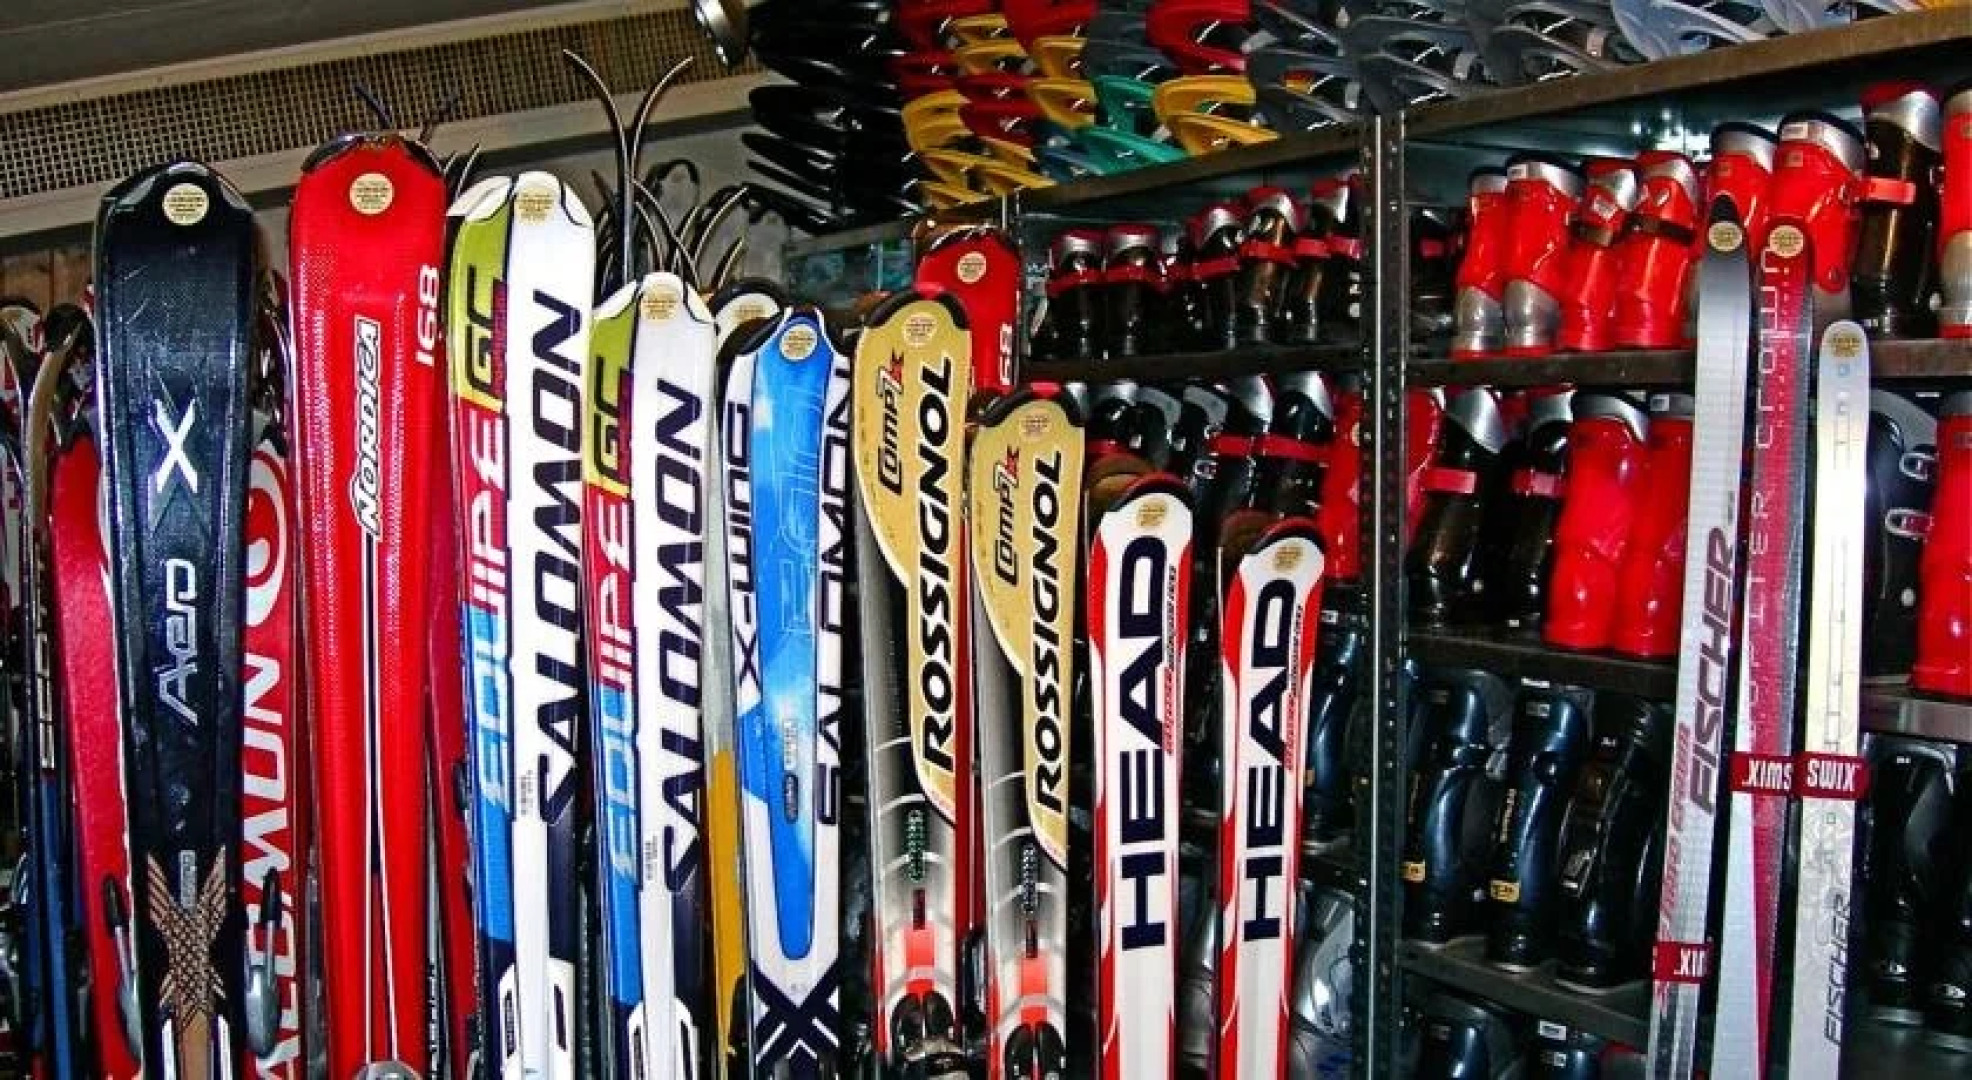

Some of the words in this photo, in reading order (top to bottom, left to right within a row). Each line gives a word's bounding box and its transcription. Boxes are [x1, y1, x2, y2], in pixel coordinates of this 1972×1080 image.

[351, 319, 380, 535] NORDICA
[416, 264, 440, 366] 168
[532, 289, 582, 826] SALOMON
[656, 378, 702, 893] SALOMON
[917, 355, 956, 772] ROSSIGNOL
[1031, 450, 1063, 813] ROSSIGNOL
[1690, 527, 1735, 816] FISCHER
[1119, 535, 1168, 951] HEAD
[1243, 579, 1297, 942] HEAD
[1746, 759, 1792, 790] SWIX
[1807, 758, 1857, 791] SWIX
[1824, 893, 1851, 1046] FISCHER
